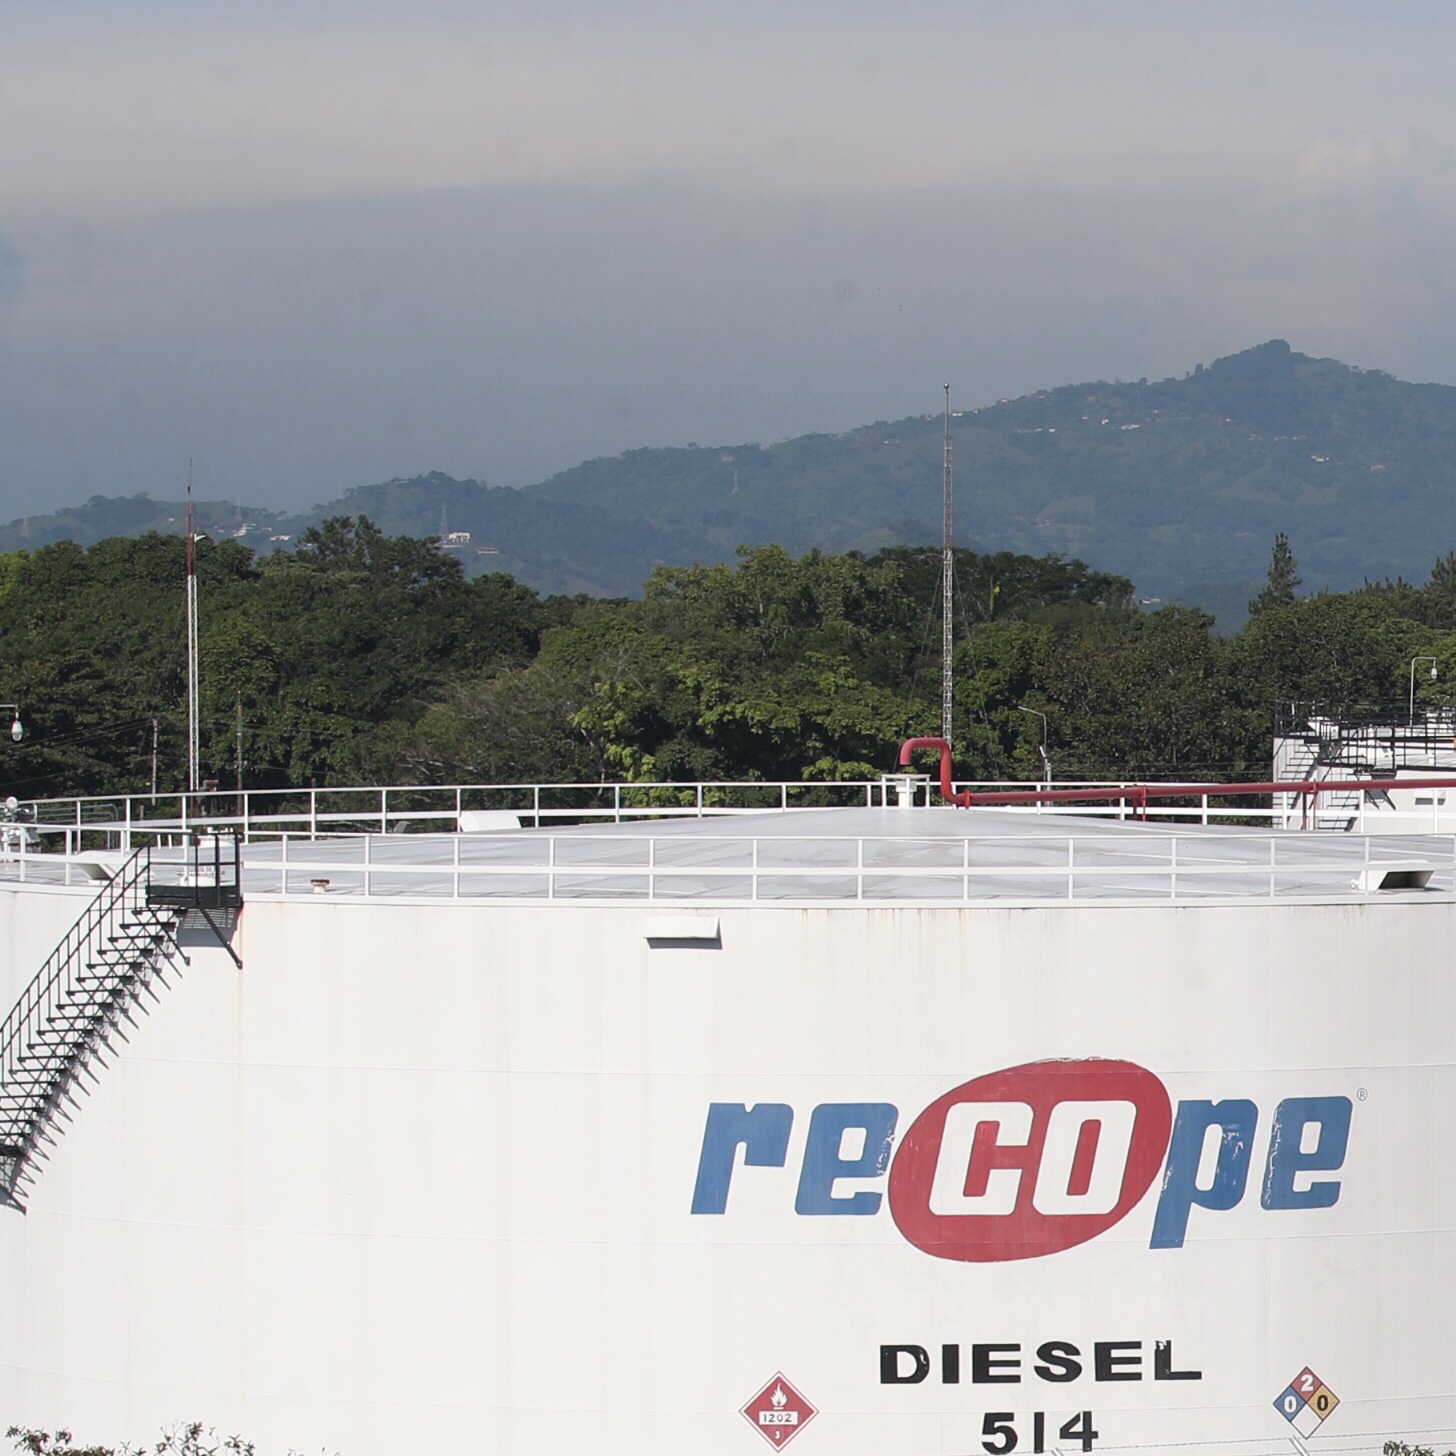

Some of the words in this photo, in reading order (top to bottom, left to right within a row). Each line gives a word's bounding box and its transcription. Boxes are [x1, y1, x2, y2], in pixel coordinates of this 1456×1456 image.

[690, 1094, 1355, 1250] recope
[879, 1340, 1203, 1385] DIESEL
[1300, 1374, 1314, 1392] 2
[1283, 1395, 1297, 1413] 0
[1316, 1394, 1329, 1412] 0
[763, 1413, 792, 1423] 1202
[980, 1410, 1100, 1455] 514
